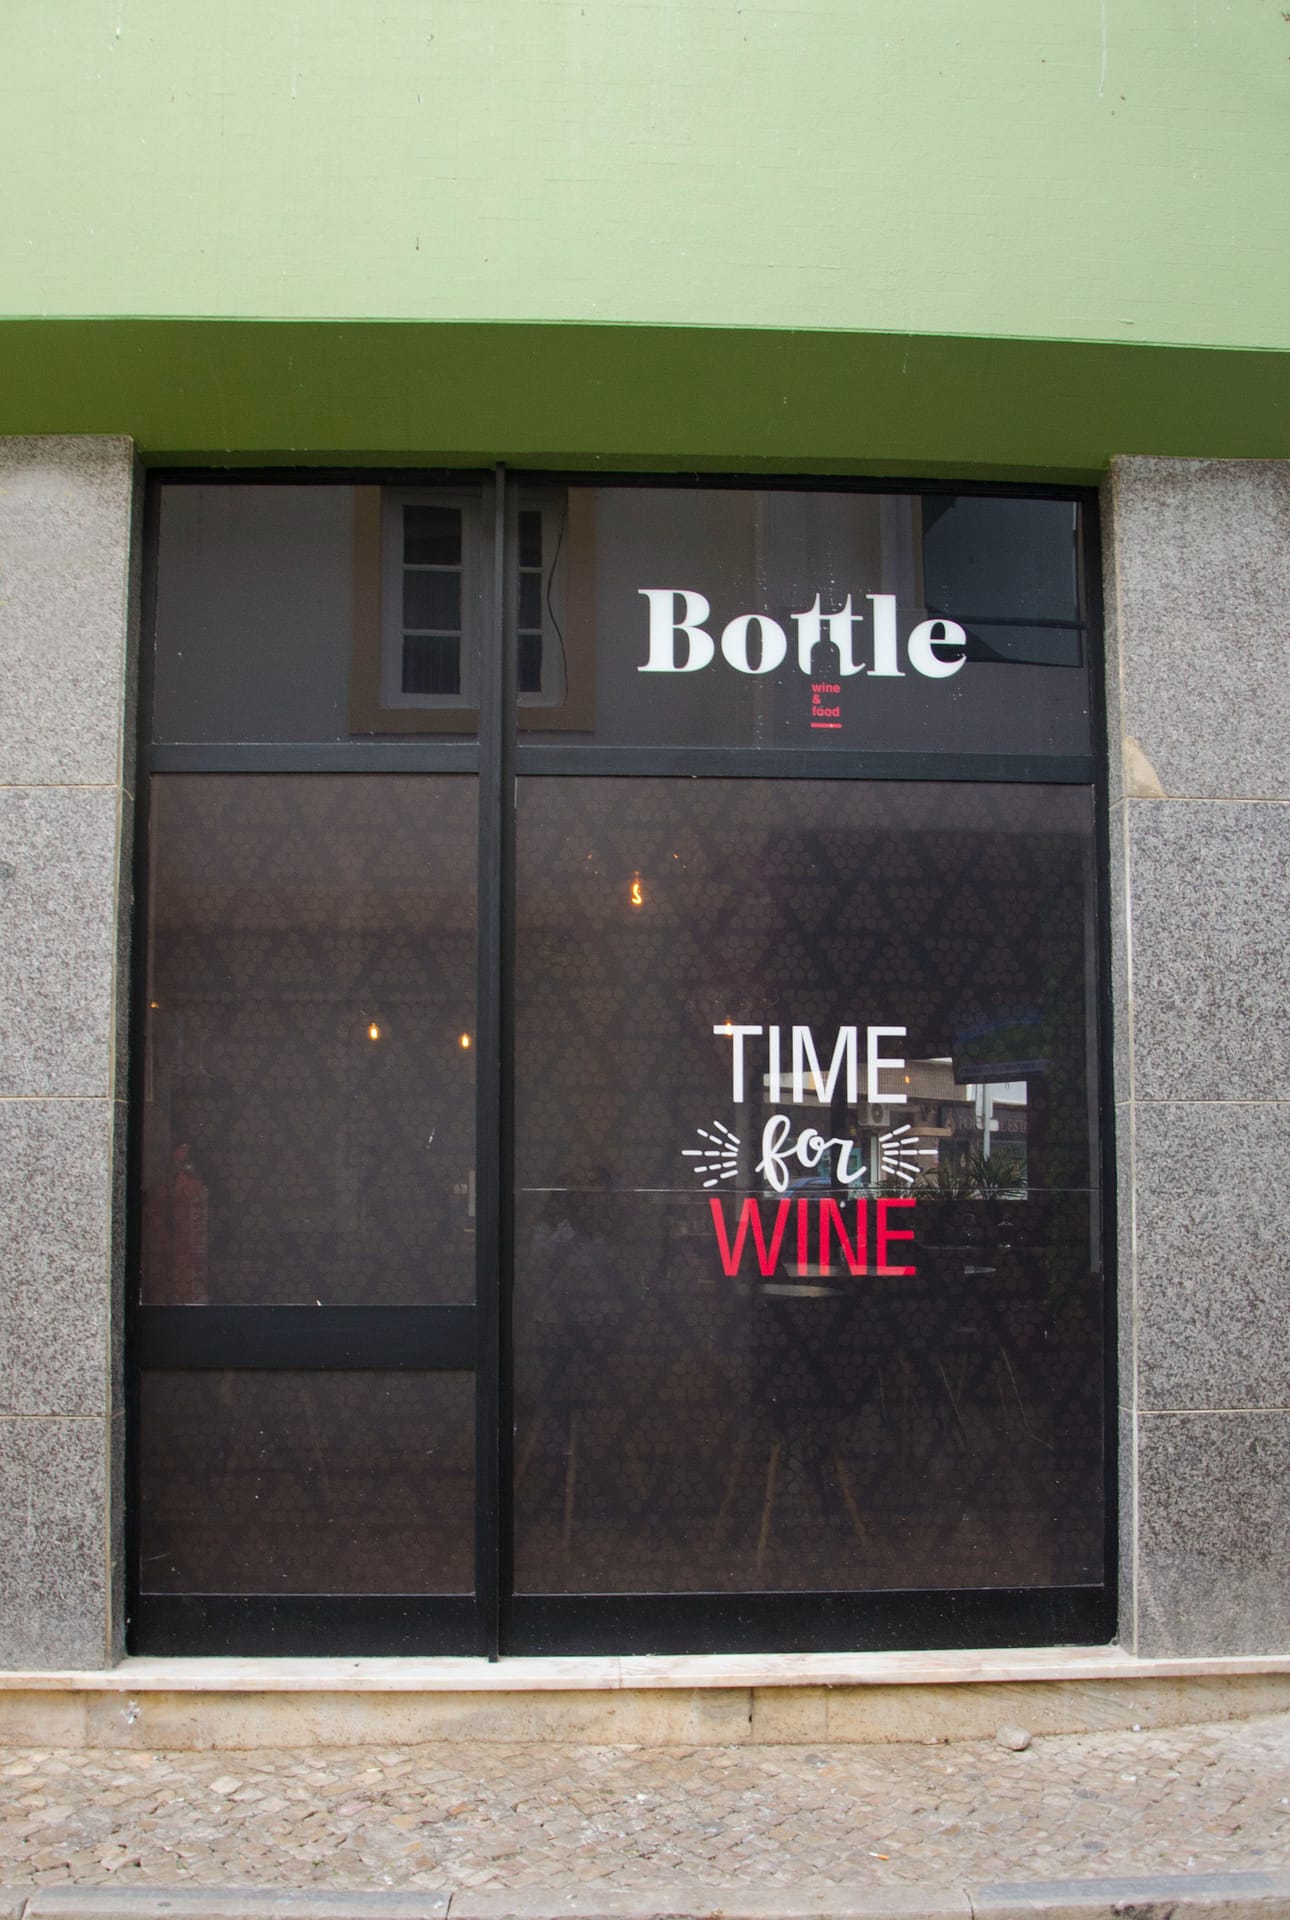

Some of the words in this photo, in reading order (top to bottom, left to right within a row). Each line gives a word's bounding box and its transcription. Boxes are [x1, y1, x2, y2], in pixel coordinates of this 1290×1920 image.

[637, 589, 967, 679] Bottle
[811, 683, 841, 694] wine
[811, 694, 821, 705] &
[811, 706, 841, 718] food
[713, 1024, 908, 1104] TIME
[755, 1114, 867, 1193] for
[709, 1197, 917, 1278] WINE
